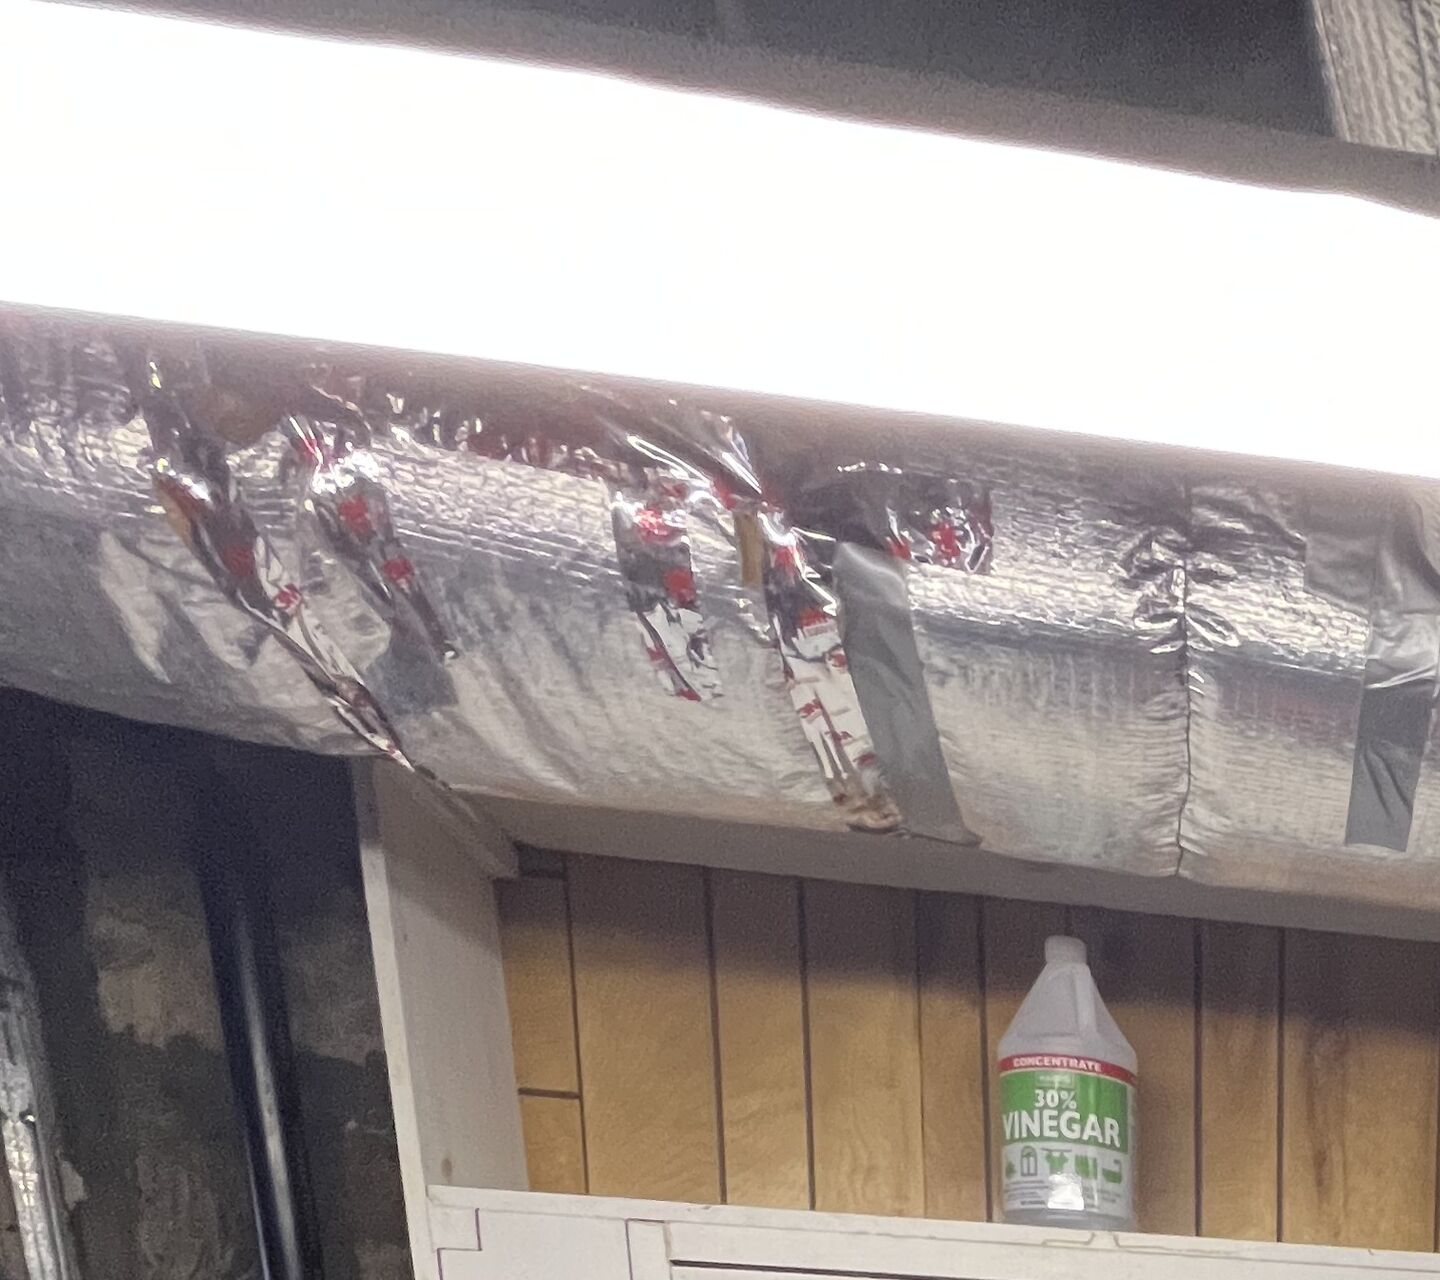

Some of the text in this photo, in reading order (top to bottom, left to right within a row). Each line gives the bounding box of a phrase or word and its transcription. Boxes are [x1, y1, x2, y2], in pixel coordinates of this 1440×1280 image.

[1013, 1056, 1102, 1072] CONCENTRATE
[1034, 1089, 1077, 1109] 30%
[1002, 1109, 1121, 1148] VINEGAR
